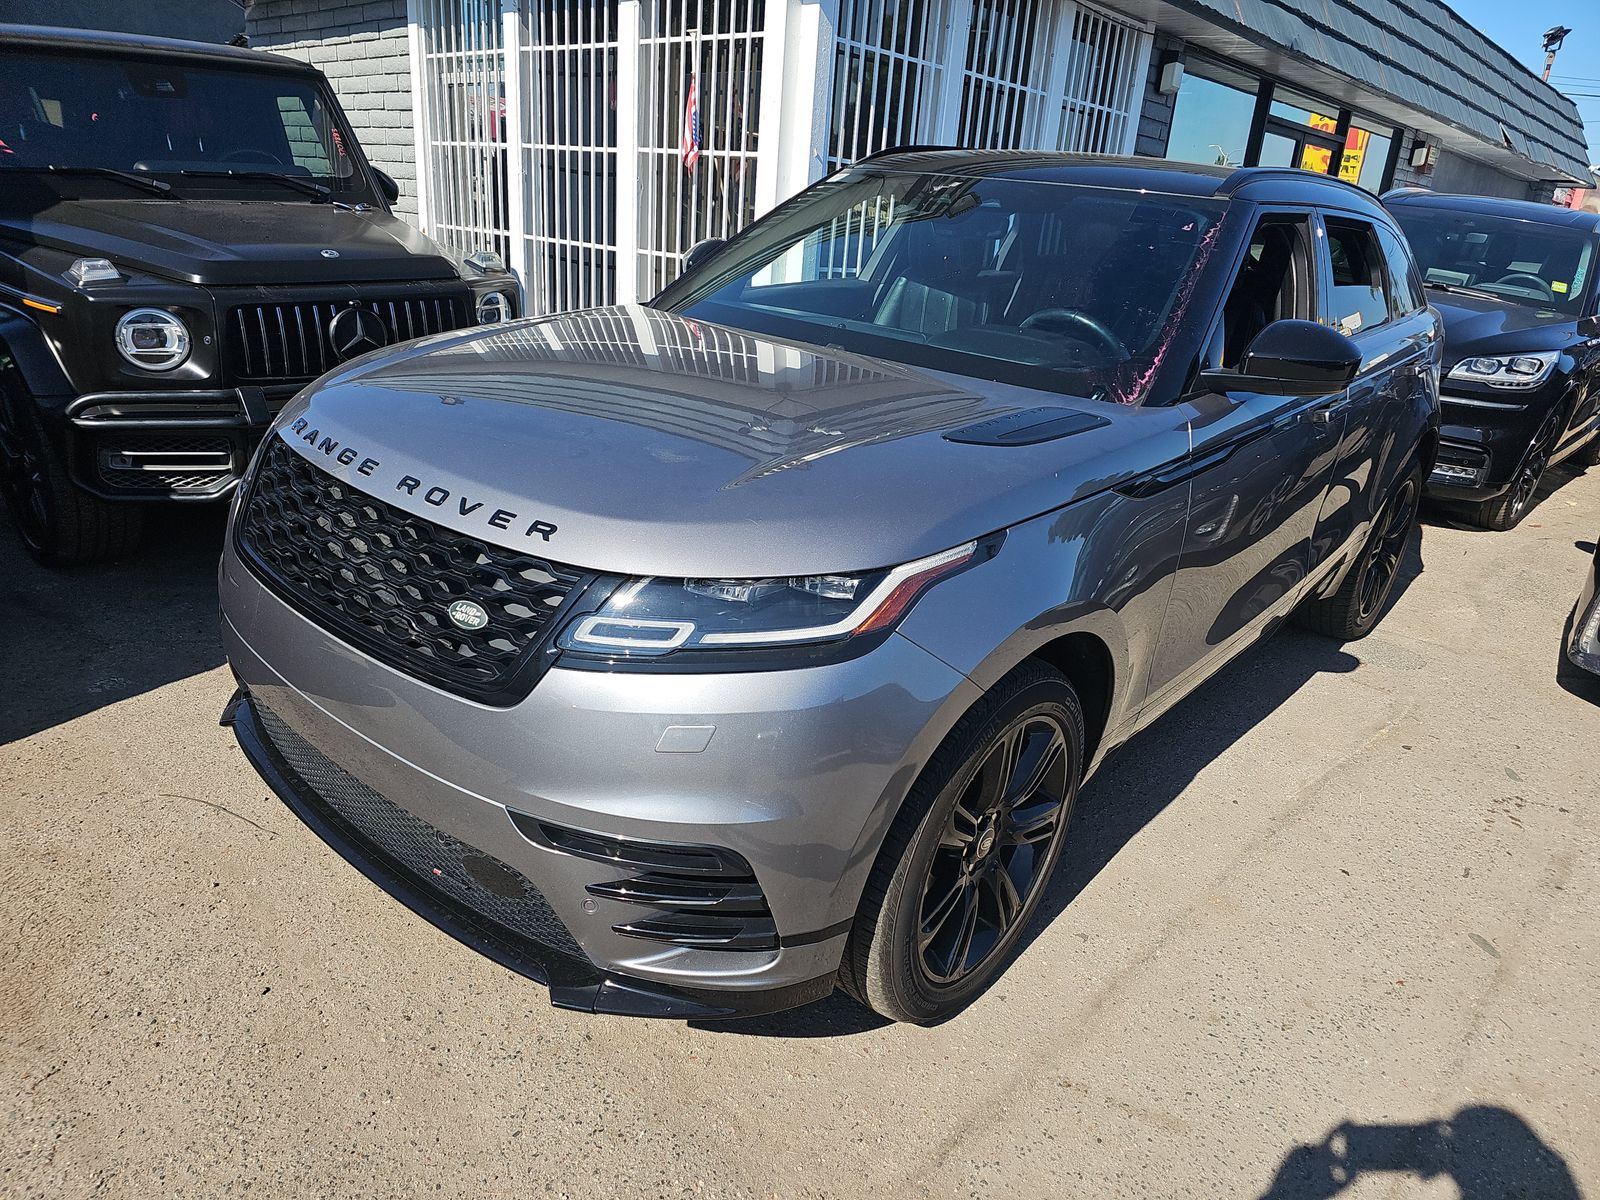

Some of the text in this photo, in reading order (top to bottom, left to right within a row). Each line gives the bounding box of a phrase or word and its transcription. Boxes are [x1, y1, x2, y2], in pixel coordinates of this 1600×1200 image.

[291, 417, 558, 542] RANGE ROVER
[455, 602, 477, 616] LAND
[454, 611, 481, 627] ROVER
